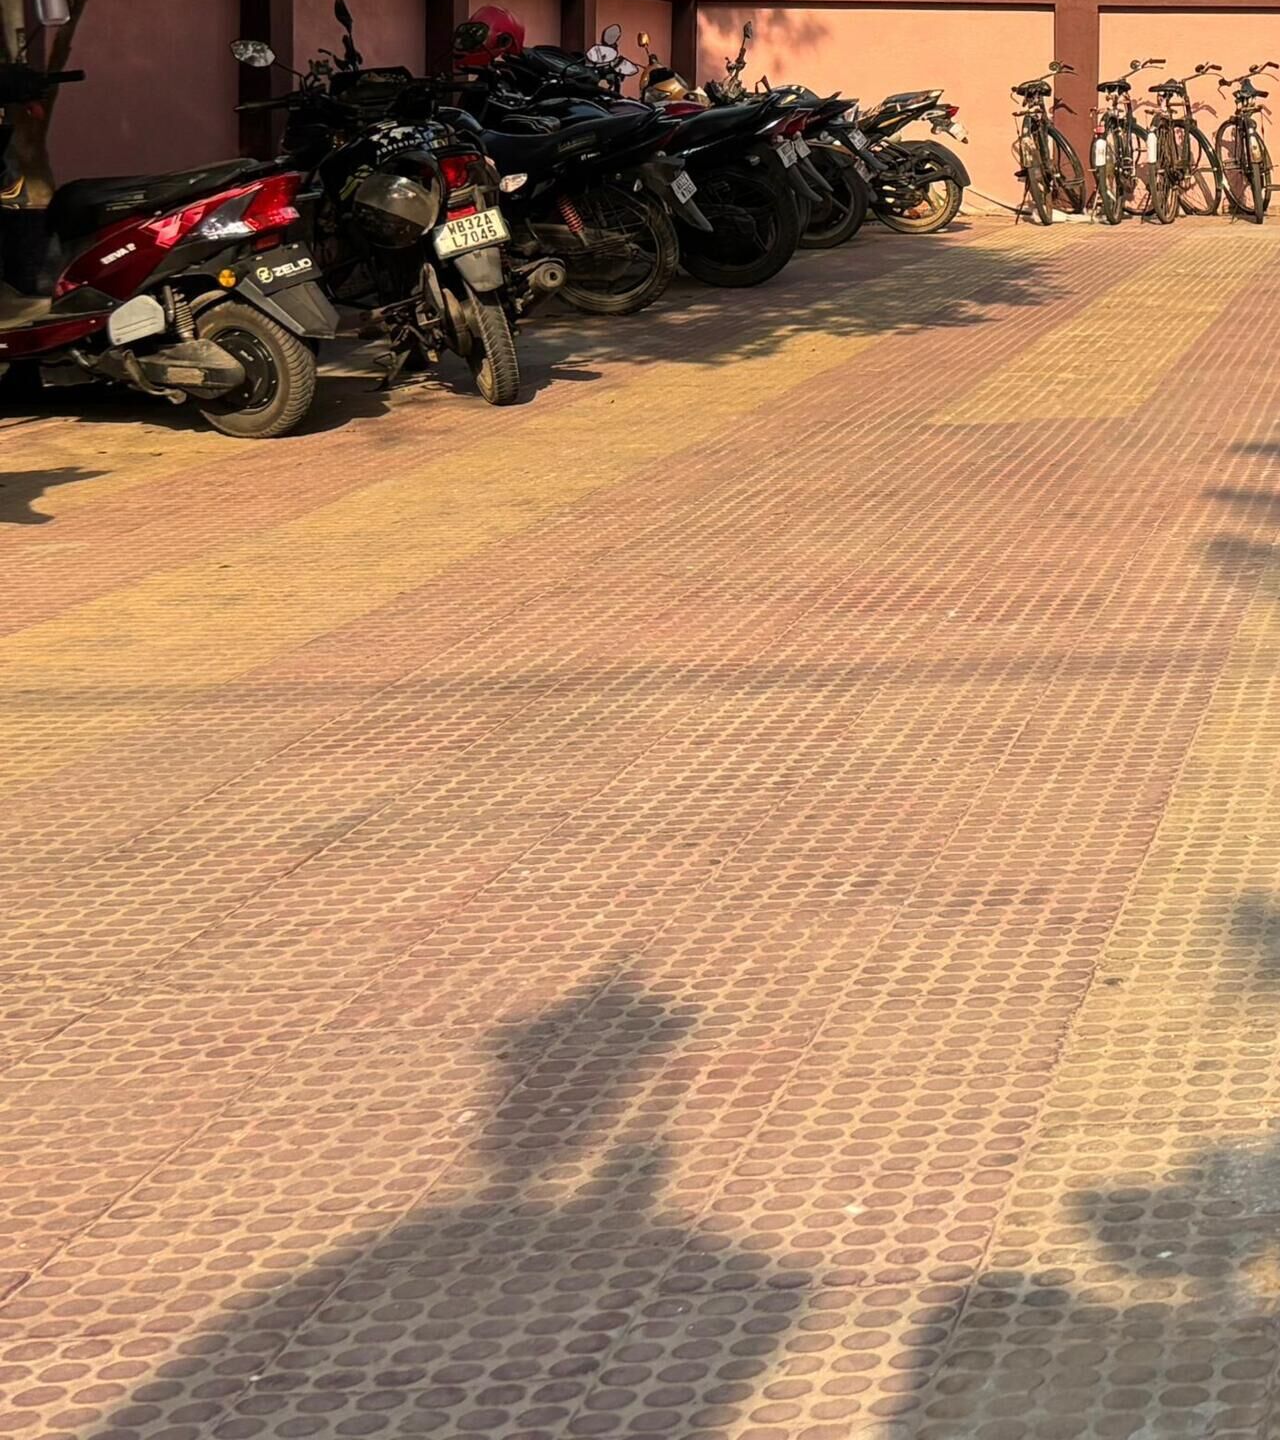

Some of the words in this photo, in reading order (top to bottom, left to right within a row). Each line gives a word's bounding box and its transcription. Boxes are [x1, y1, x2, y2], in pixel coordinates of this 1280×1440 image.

[447, 213, 492, 235] WB32A
[452, 225, 497, 248] L7045
[272, 258, 312, 277] ZELIO
